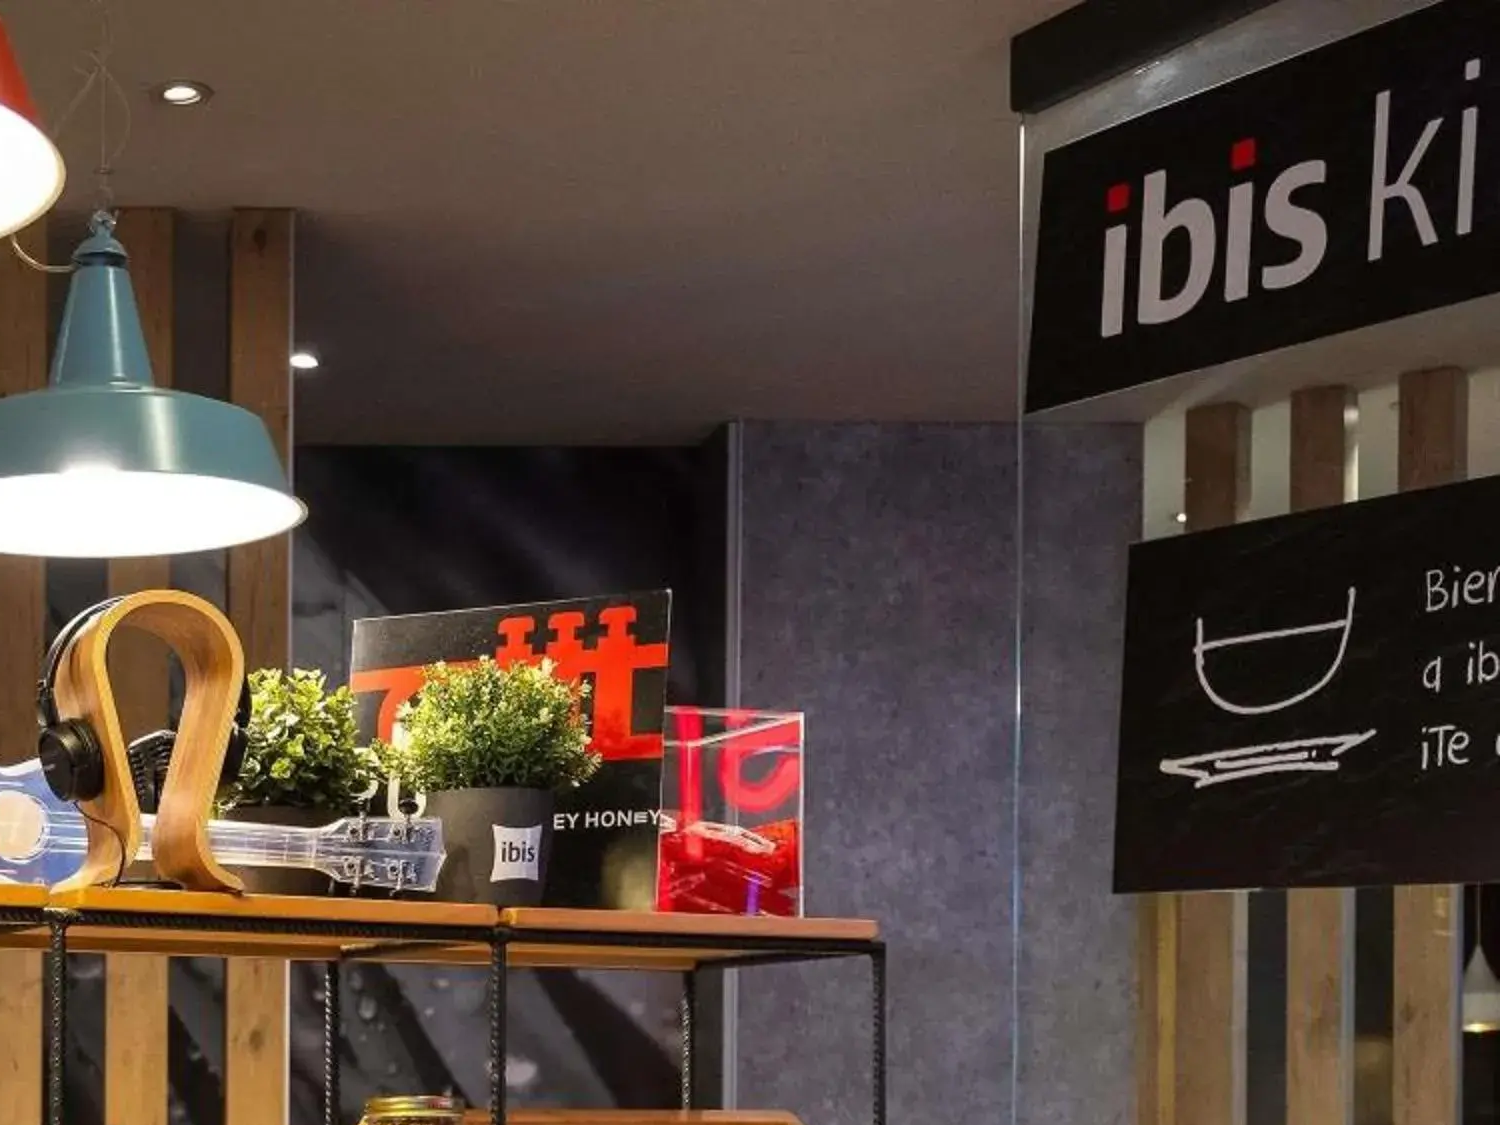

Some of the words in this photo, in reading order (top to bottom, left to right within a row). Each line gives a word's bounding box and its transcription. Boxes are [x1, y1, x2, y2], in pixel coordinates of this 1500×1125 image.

[1101, 138, 1327, 338] ibis
[1368, 58, 1481, 261] ki
[585, 809, 663, 829] HONEY
[501, 841, 536, 864] ibis
